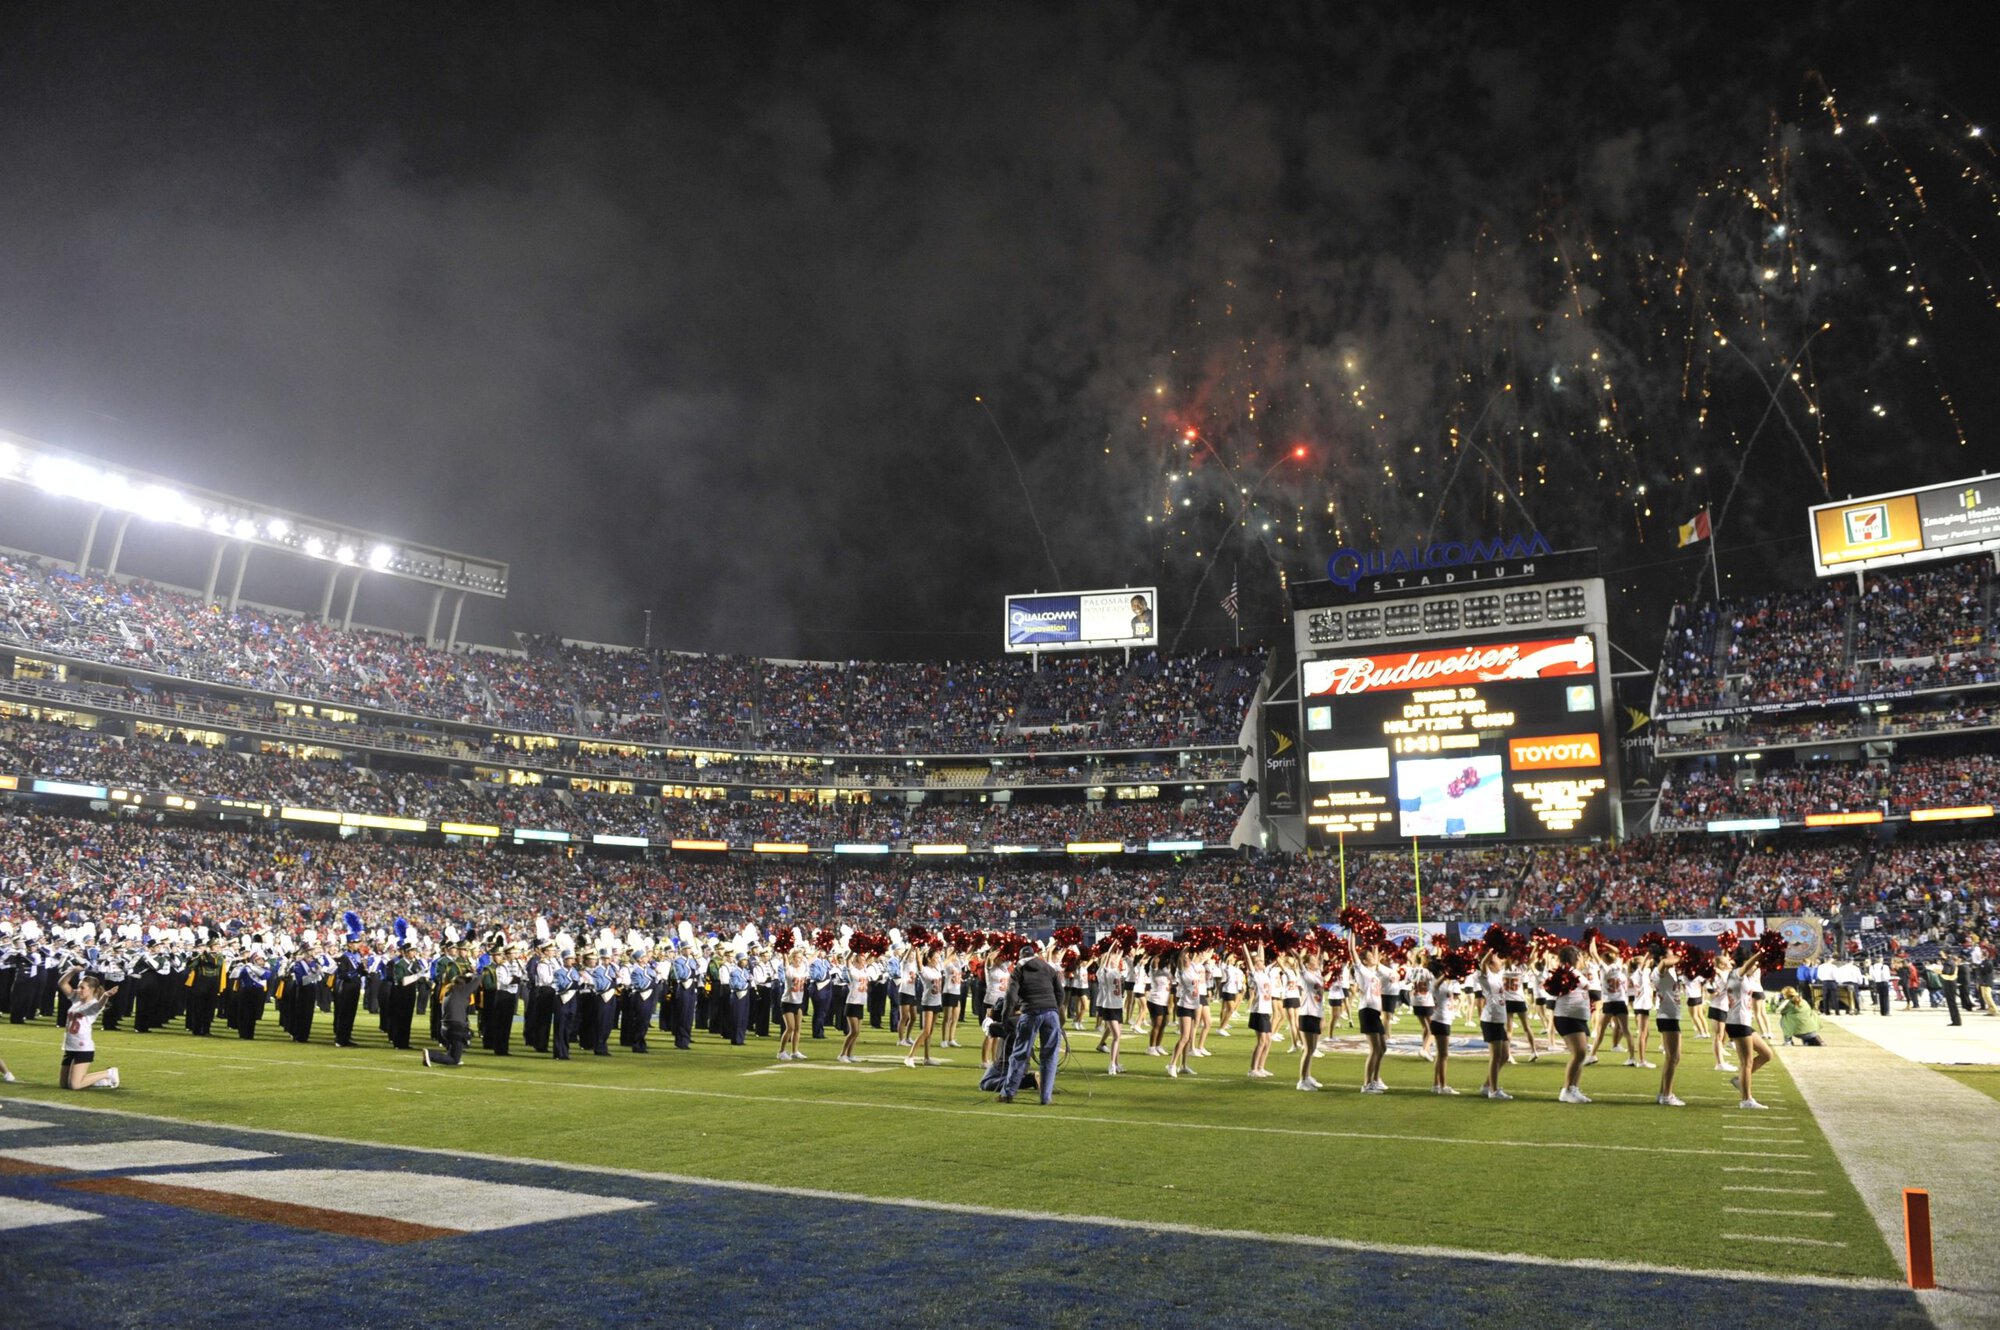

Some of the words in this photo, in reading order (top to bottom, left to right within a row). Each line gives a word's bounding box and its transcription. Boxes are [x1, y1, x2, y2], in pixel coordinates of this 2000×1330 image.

[1327, 531, 1552, 592] QUALCOMM
[1373, 563, 1535, 591] STADIUM
[1012, 610, 1078, 627] QUALCOMM
[1024, 624, 1067, 633] Innovation
[1330, 646, 1520, 694] Budweiser
[1403, 704, 1425, 718] DR
[1429, 699, 1487, 716] PEPPER
[1825, 696, 1853, 704] OCATION
[1620, 735, 1654, 748] Sprint
[1514, 742, 1596, 763] TOYOTA
[1266, 757, 1296, 770] Sprint
[1735, 920, 1758, 939] N
